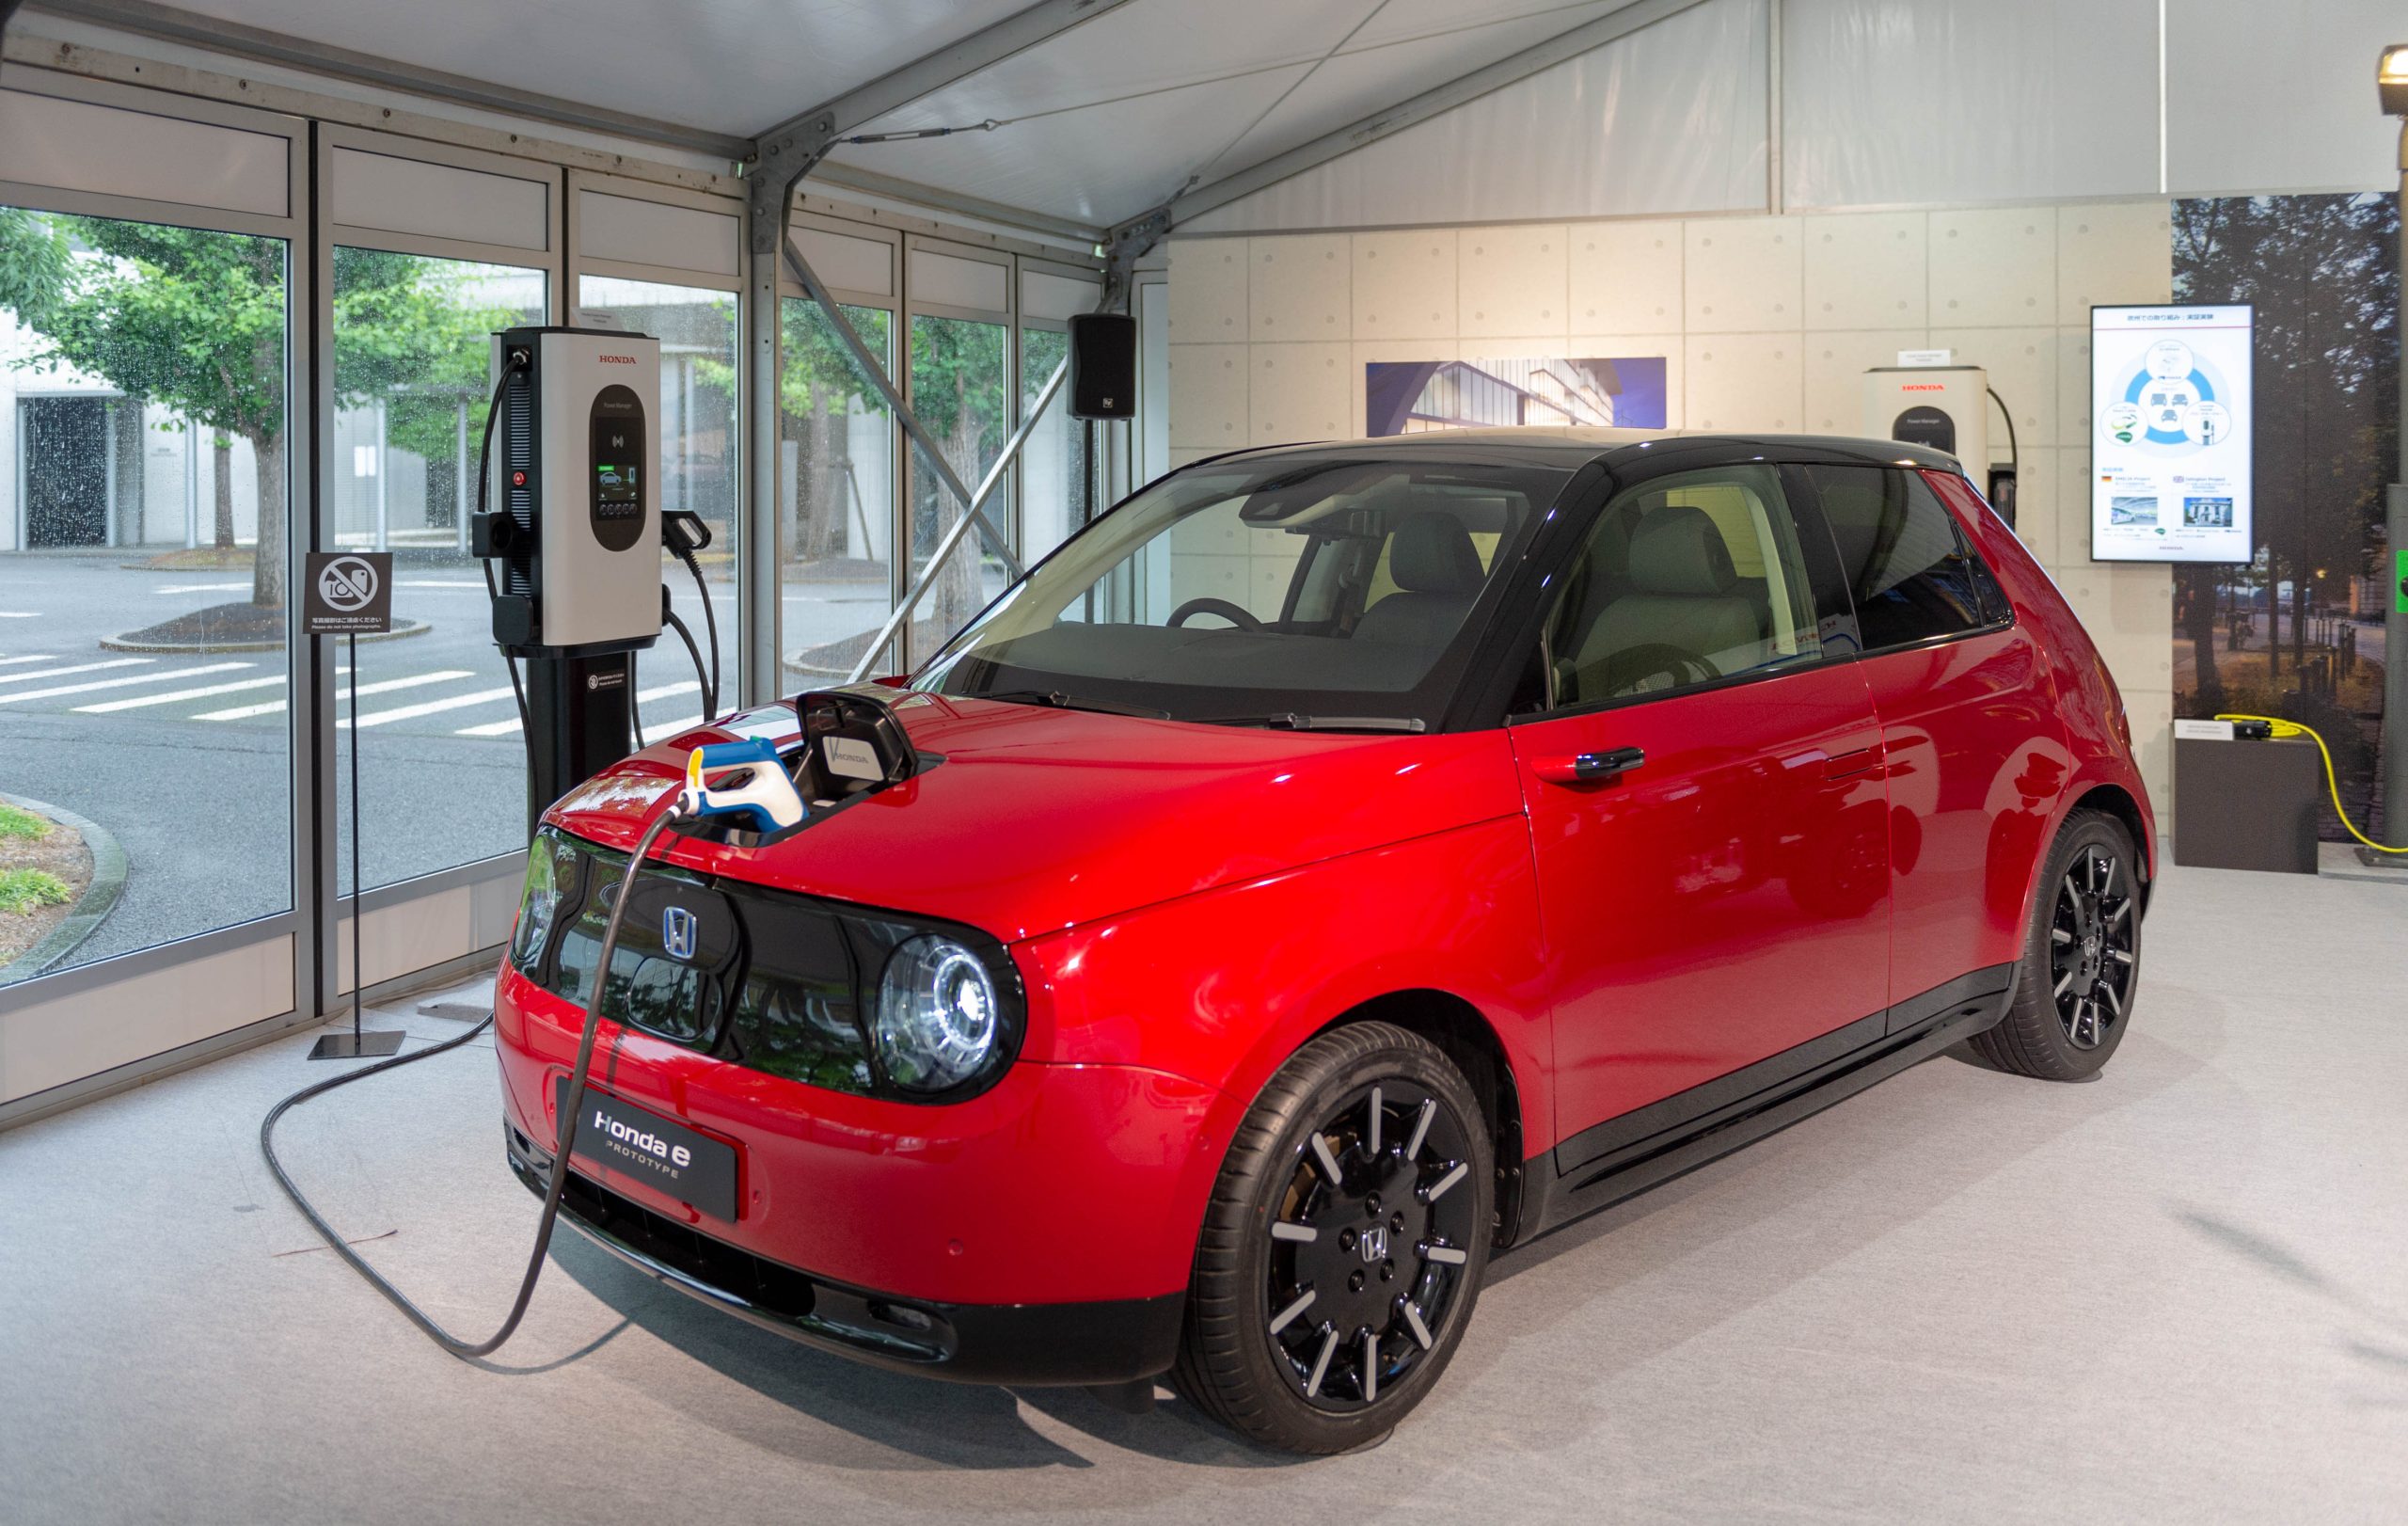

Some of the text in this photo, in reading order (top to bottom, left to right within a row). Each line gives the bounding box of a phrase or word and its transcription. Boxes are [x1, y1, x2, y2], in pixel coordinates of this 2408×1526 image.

[599, 356, 636, 364] HONDA
[594, 1110, 691, 1167] Honda e
[605, 1139, 679, 1179] PROTOTYPE
